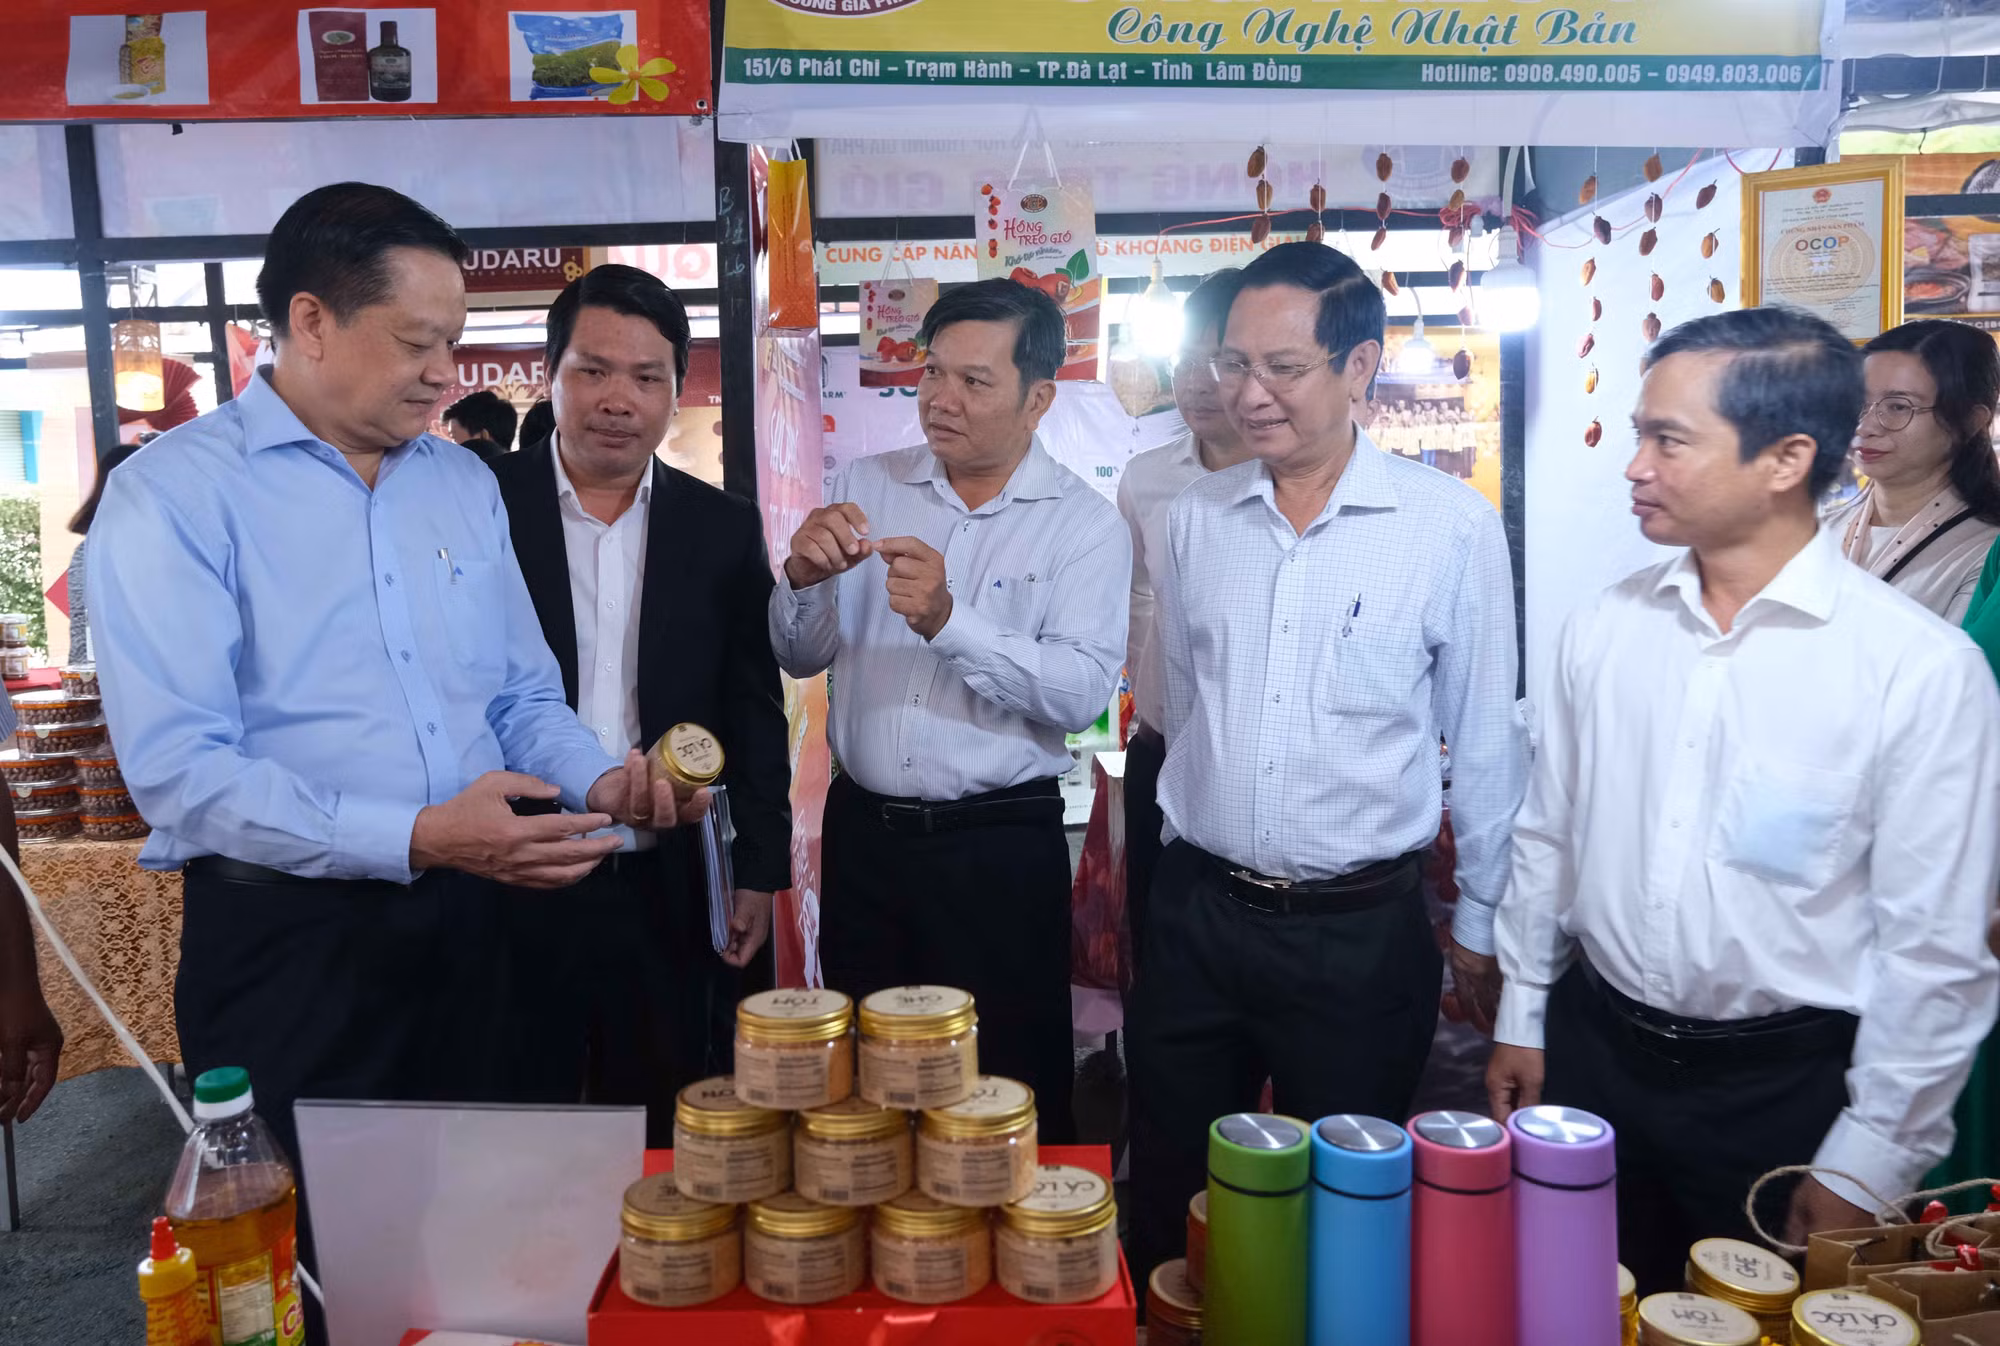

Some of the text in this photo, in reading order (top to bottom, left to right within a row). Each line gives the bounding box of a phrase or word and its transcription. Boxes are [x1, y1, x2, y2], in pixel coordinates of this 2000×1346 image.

[1107, 7, 1641, 54] Công Nghệ Nhật Bản
[743, 57, 792, 78] 151/6
[799, 57, 842, 77] Phát
[850, 58, 880, 77] Chi
[905, 59, 956, 81] Trạm
[964, 60, 1012, 78] Hành
[1037, 60, 1091, 80] TP.Đà
[1099, 61, 1127, 83] Lạt
[1152, 59, 1193, 80] Tỉnh
[1206, 61, 1245, 81] Lâm
[1252, 58, 1302, 83] Đồng
[1421, 63, 1498, 83] Hotline:
[1504, 63, 1641, 84] 0908.490.005
[1664, 64, 1802, 85] 0949.803.006
[826, 246, 883, 263] CUNG
[934, 242, 978, 260] NĂN
[1209, 233, 1254, 255] ĐIỆN
[1018, 230, 1072, 246] TREO GIÓ
[1795, 235, 1850, 252] OCOP
[462, 248, 561, 270] UDARU
[458, 361, 545, 387] UDAR
[1671, 1308, 1725, 1325] TÔM
[1811, 1310, 1898, 1330] CÁ LÓC
